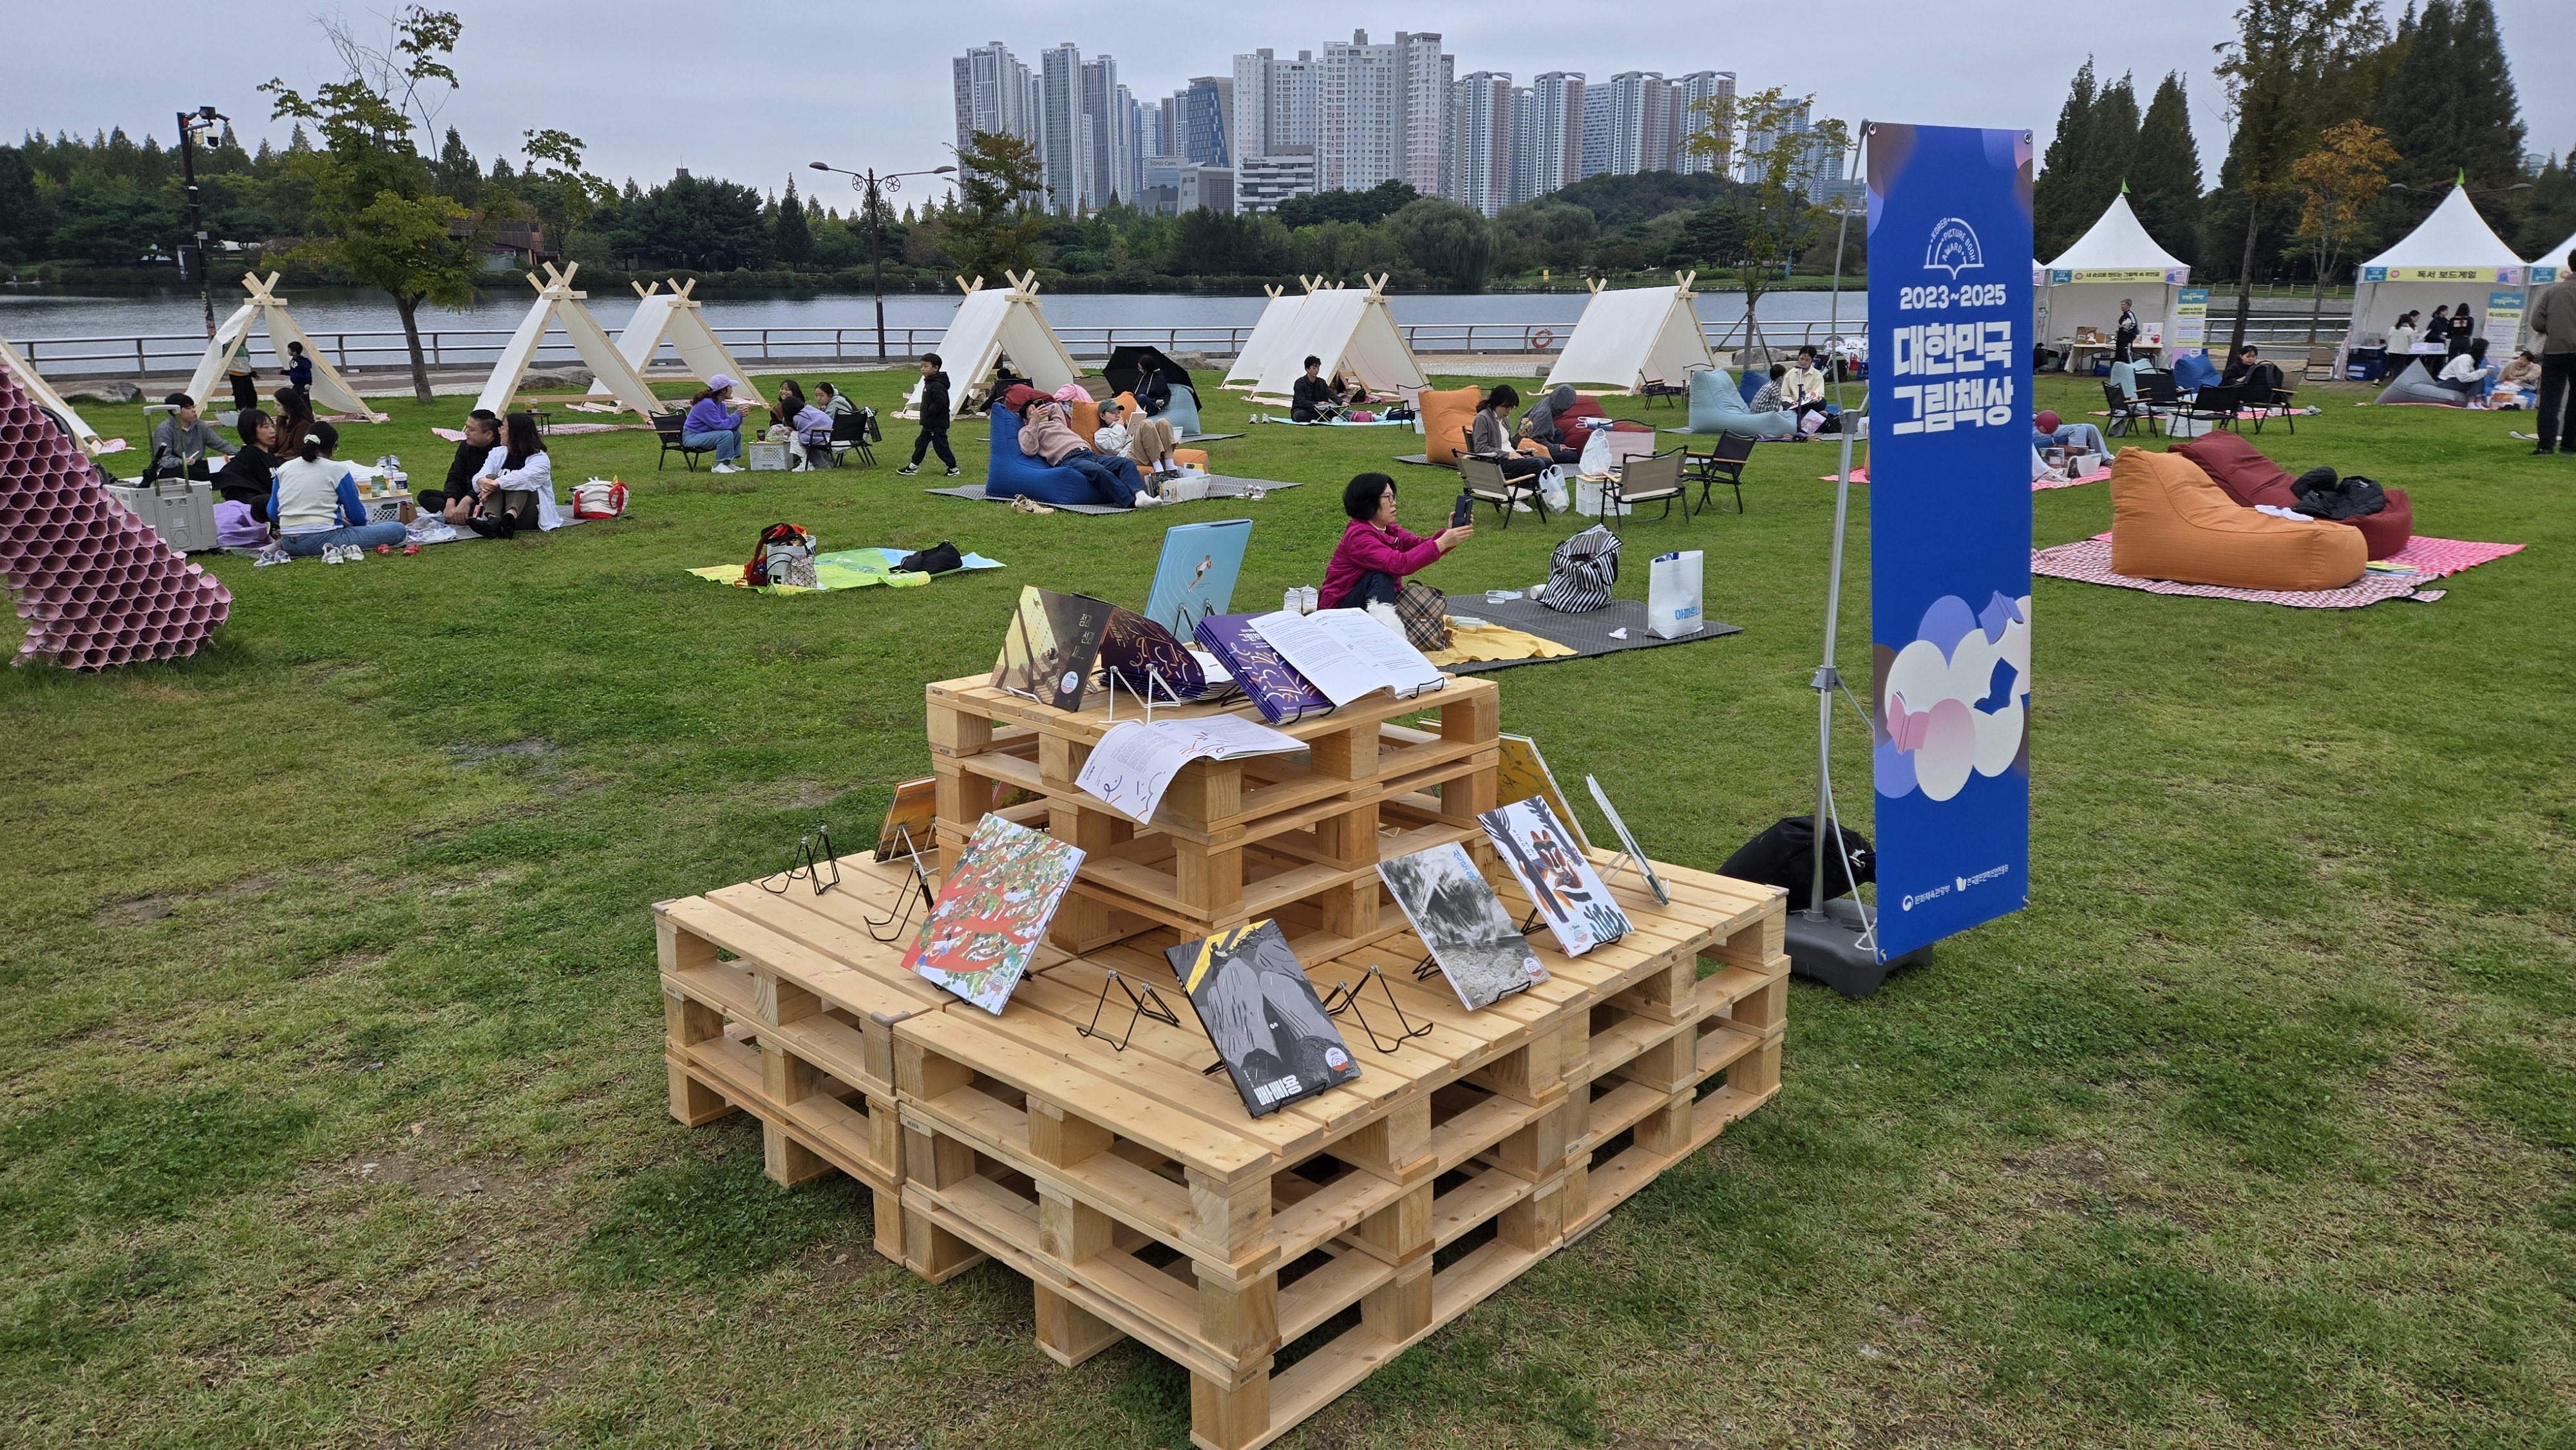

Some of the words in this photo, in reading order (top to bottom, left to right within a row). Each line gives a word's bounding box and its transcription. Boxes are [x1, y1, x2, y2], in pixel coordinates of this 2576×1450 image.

[1931, 217, 1949, 240] KOREA
[1941, 242, 1963, 261] AWARD
[1943, 229, 1965, 241] PICTURE
[1964, 238, 1976, 261] BOOK
[2417, 270, 2436, 279] 독서
[2439, 270, 2476, 279] 보드게임
[1899, 283, 2007, 310] 2023~2025
[1893, 321, 2013, 377] 대한민국
[1893, 375, 2014, 435] 그림책상
[1675, 605, 1700, 621] 아파트너
[1915, 885, 1951, 905] 문화체육관광부
[1253, 1074, 1303, 1106] 빠삐용
